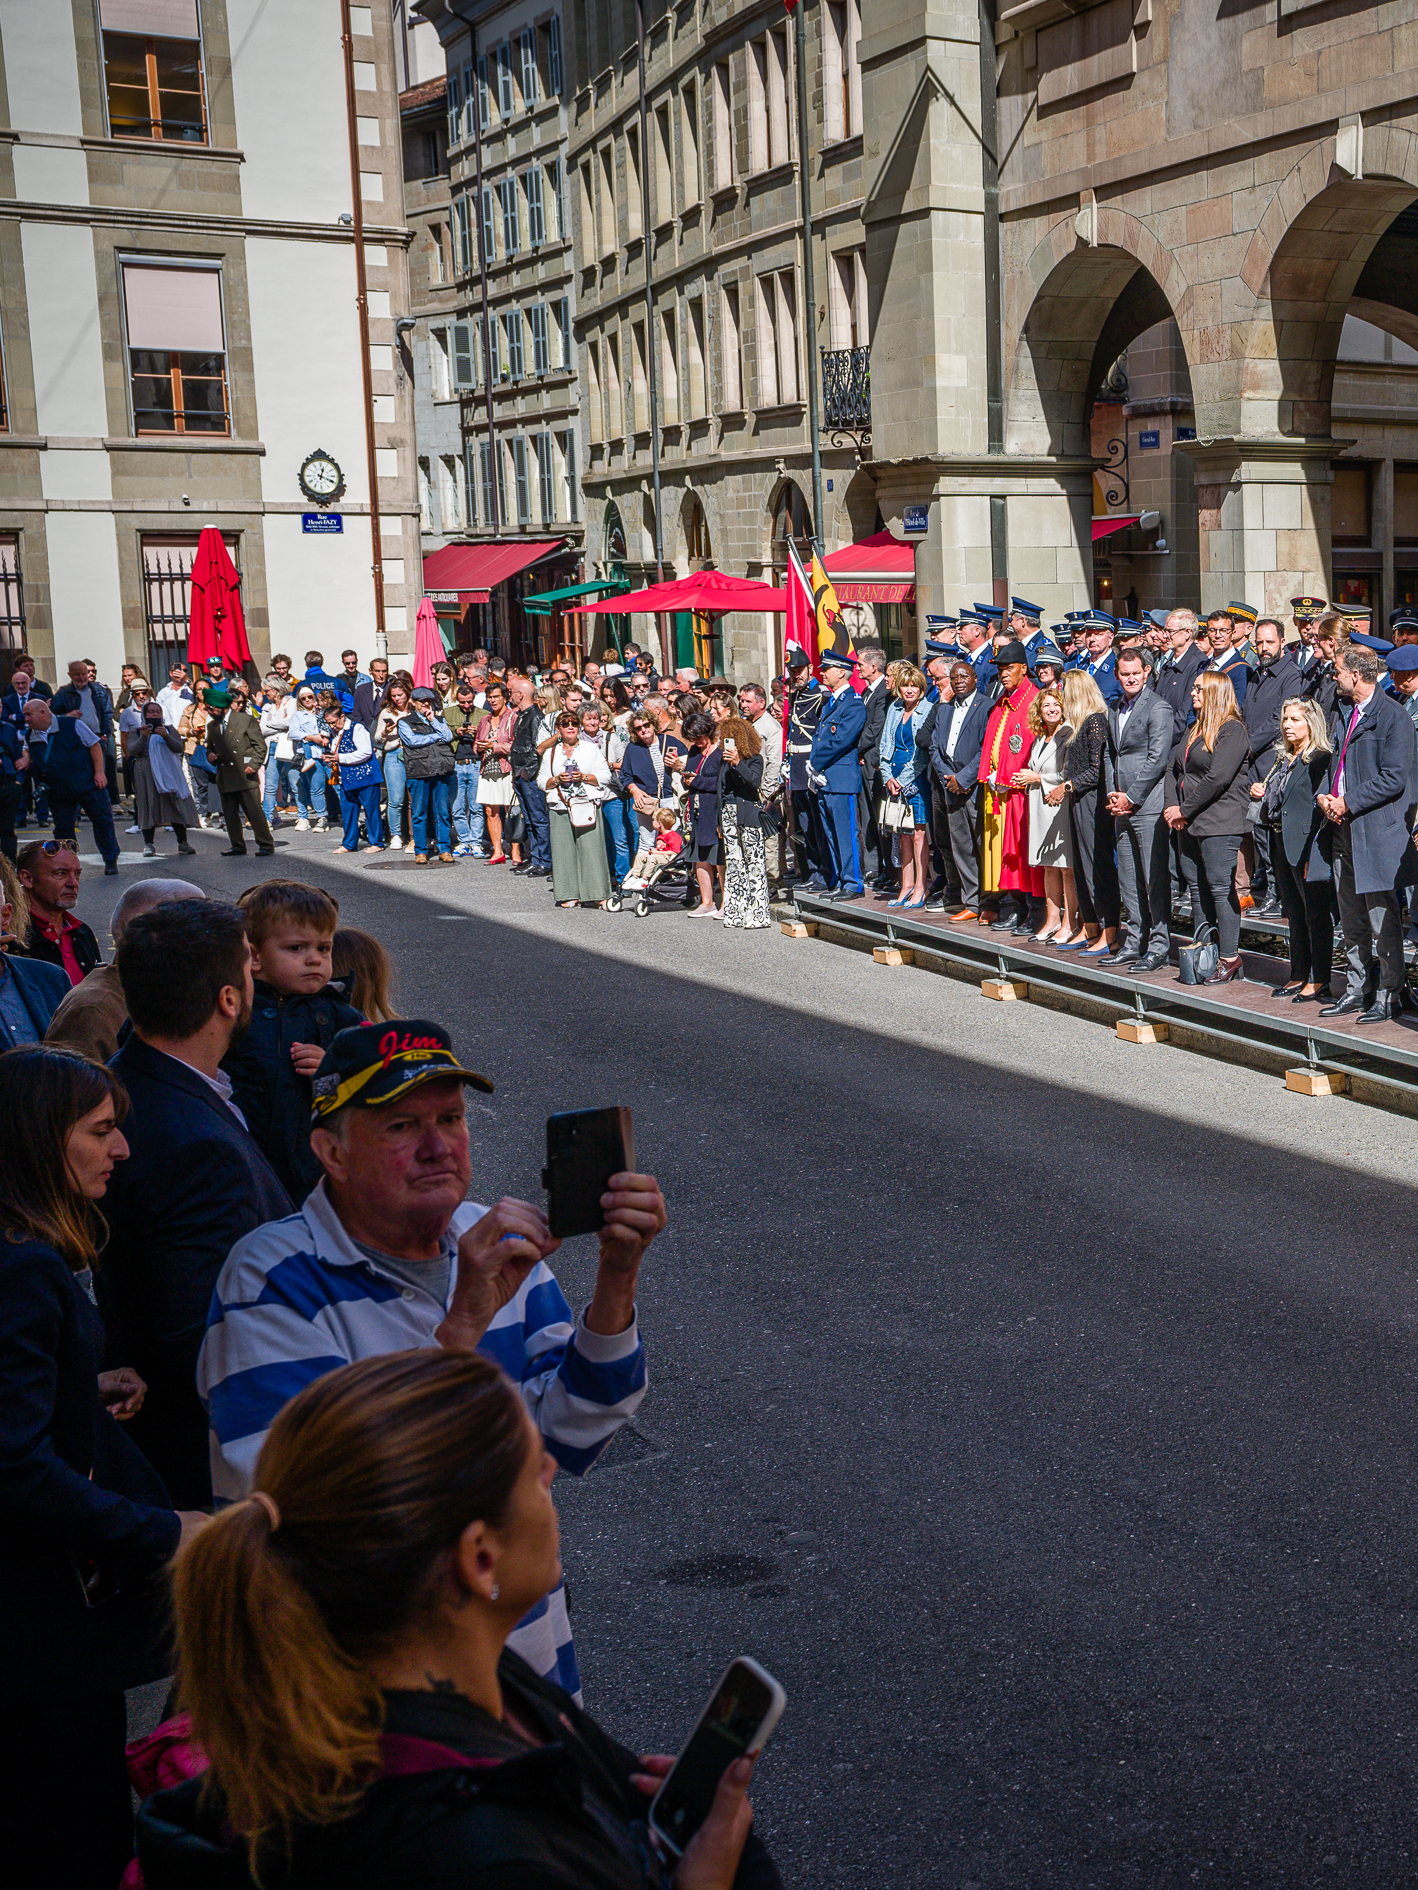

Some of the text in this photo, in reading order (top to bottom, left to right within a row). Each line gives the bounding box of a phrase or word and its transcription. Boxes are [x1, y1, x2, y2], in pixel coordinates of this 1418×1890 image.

[833, 584, 888, 600] STAURANT
[888, 585, 905, 601] DE
[310, 682, 336, 690] POLICE
[378, 1030, 444, 1070] Jim
